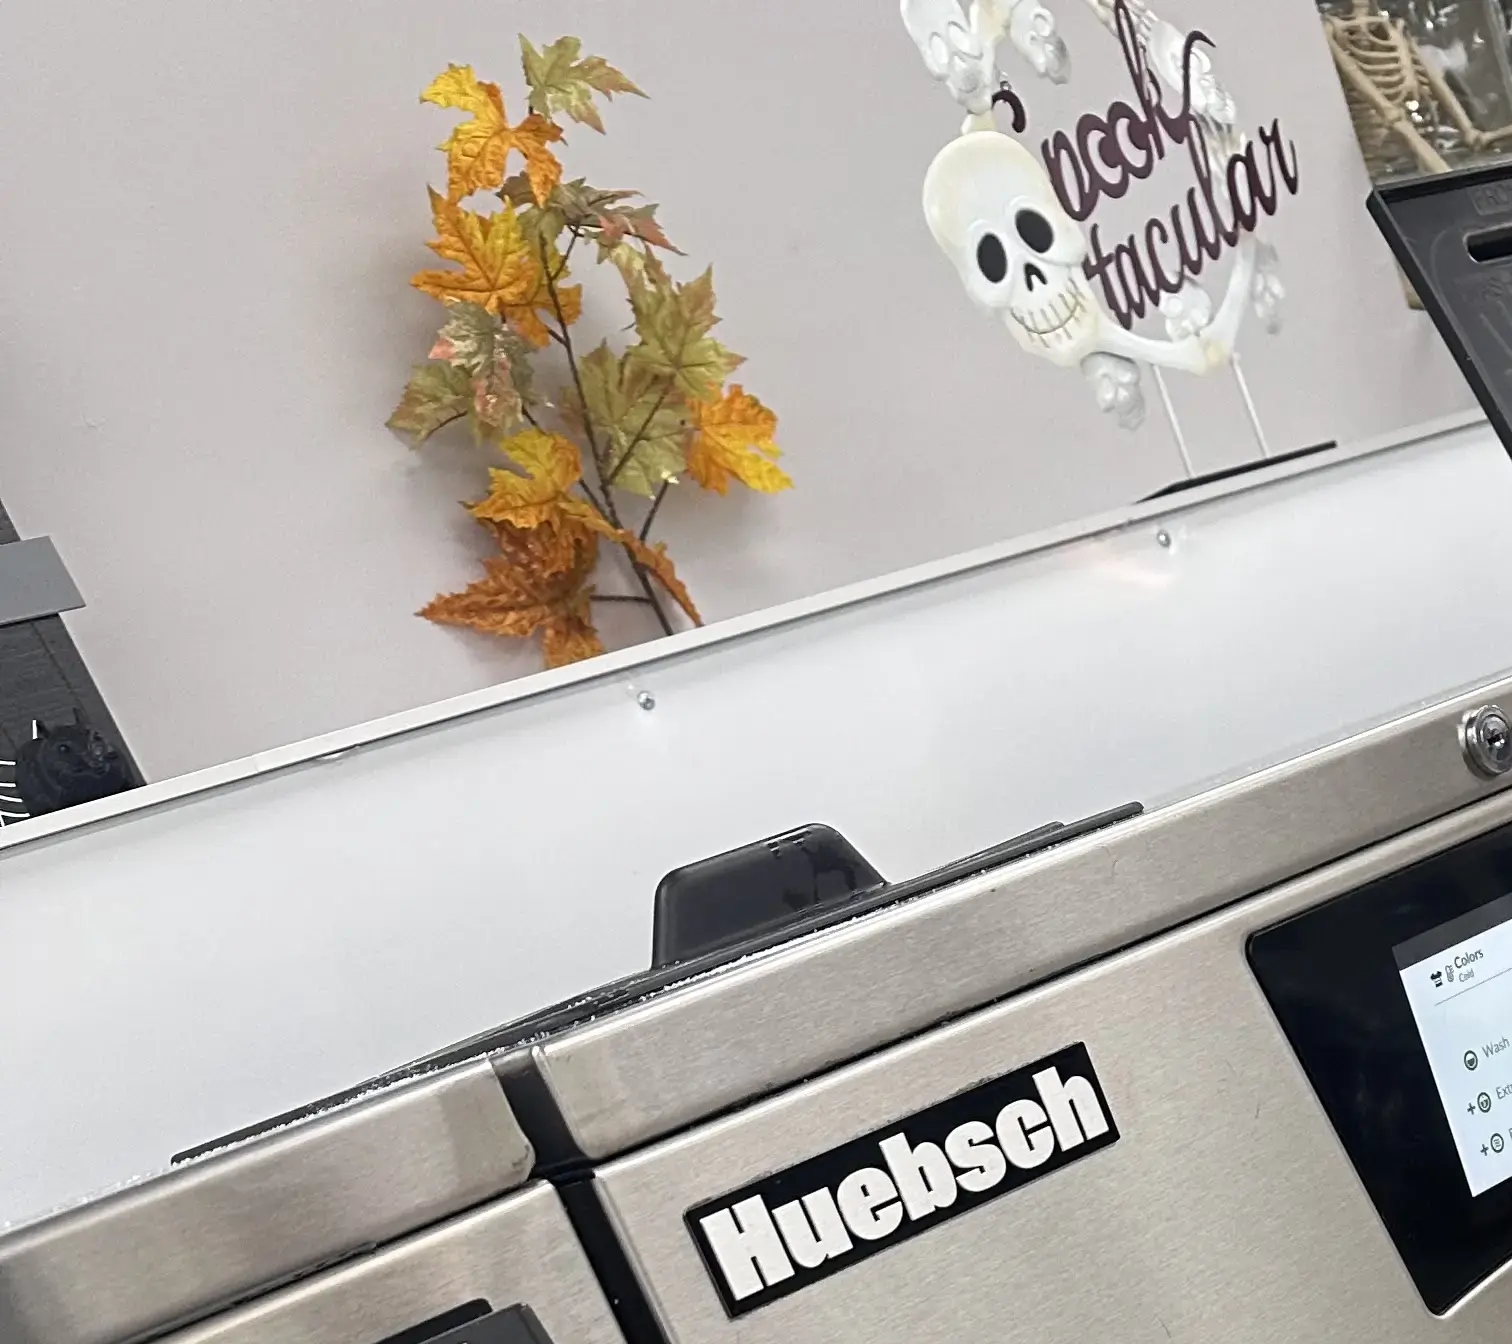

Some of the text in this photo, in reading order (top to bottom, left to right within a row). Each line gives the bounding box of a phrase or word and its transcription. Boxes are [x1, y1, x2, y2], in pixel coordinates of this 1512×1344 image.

[991, 0, 1216, 221] pook
[1083, 113, 1298, 330] tacular
[1453, 947, 1484, 971] Colors
[1457, 967, 1475, 984] Cold
[1481, 1034, 1510, 1059] Wash
[700, 1066, 1110, 1300] Huebsch
